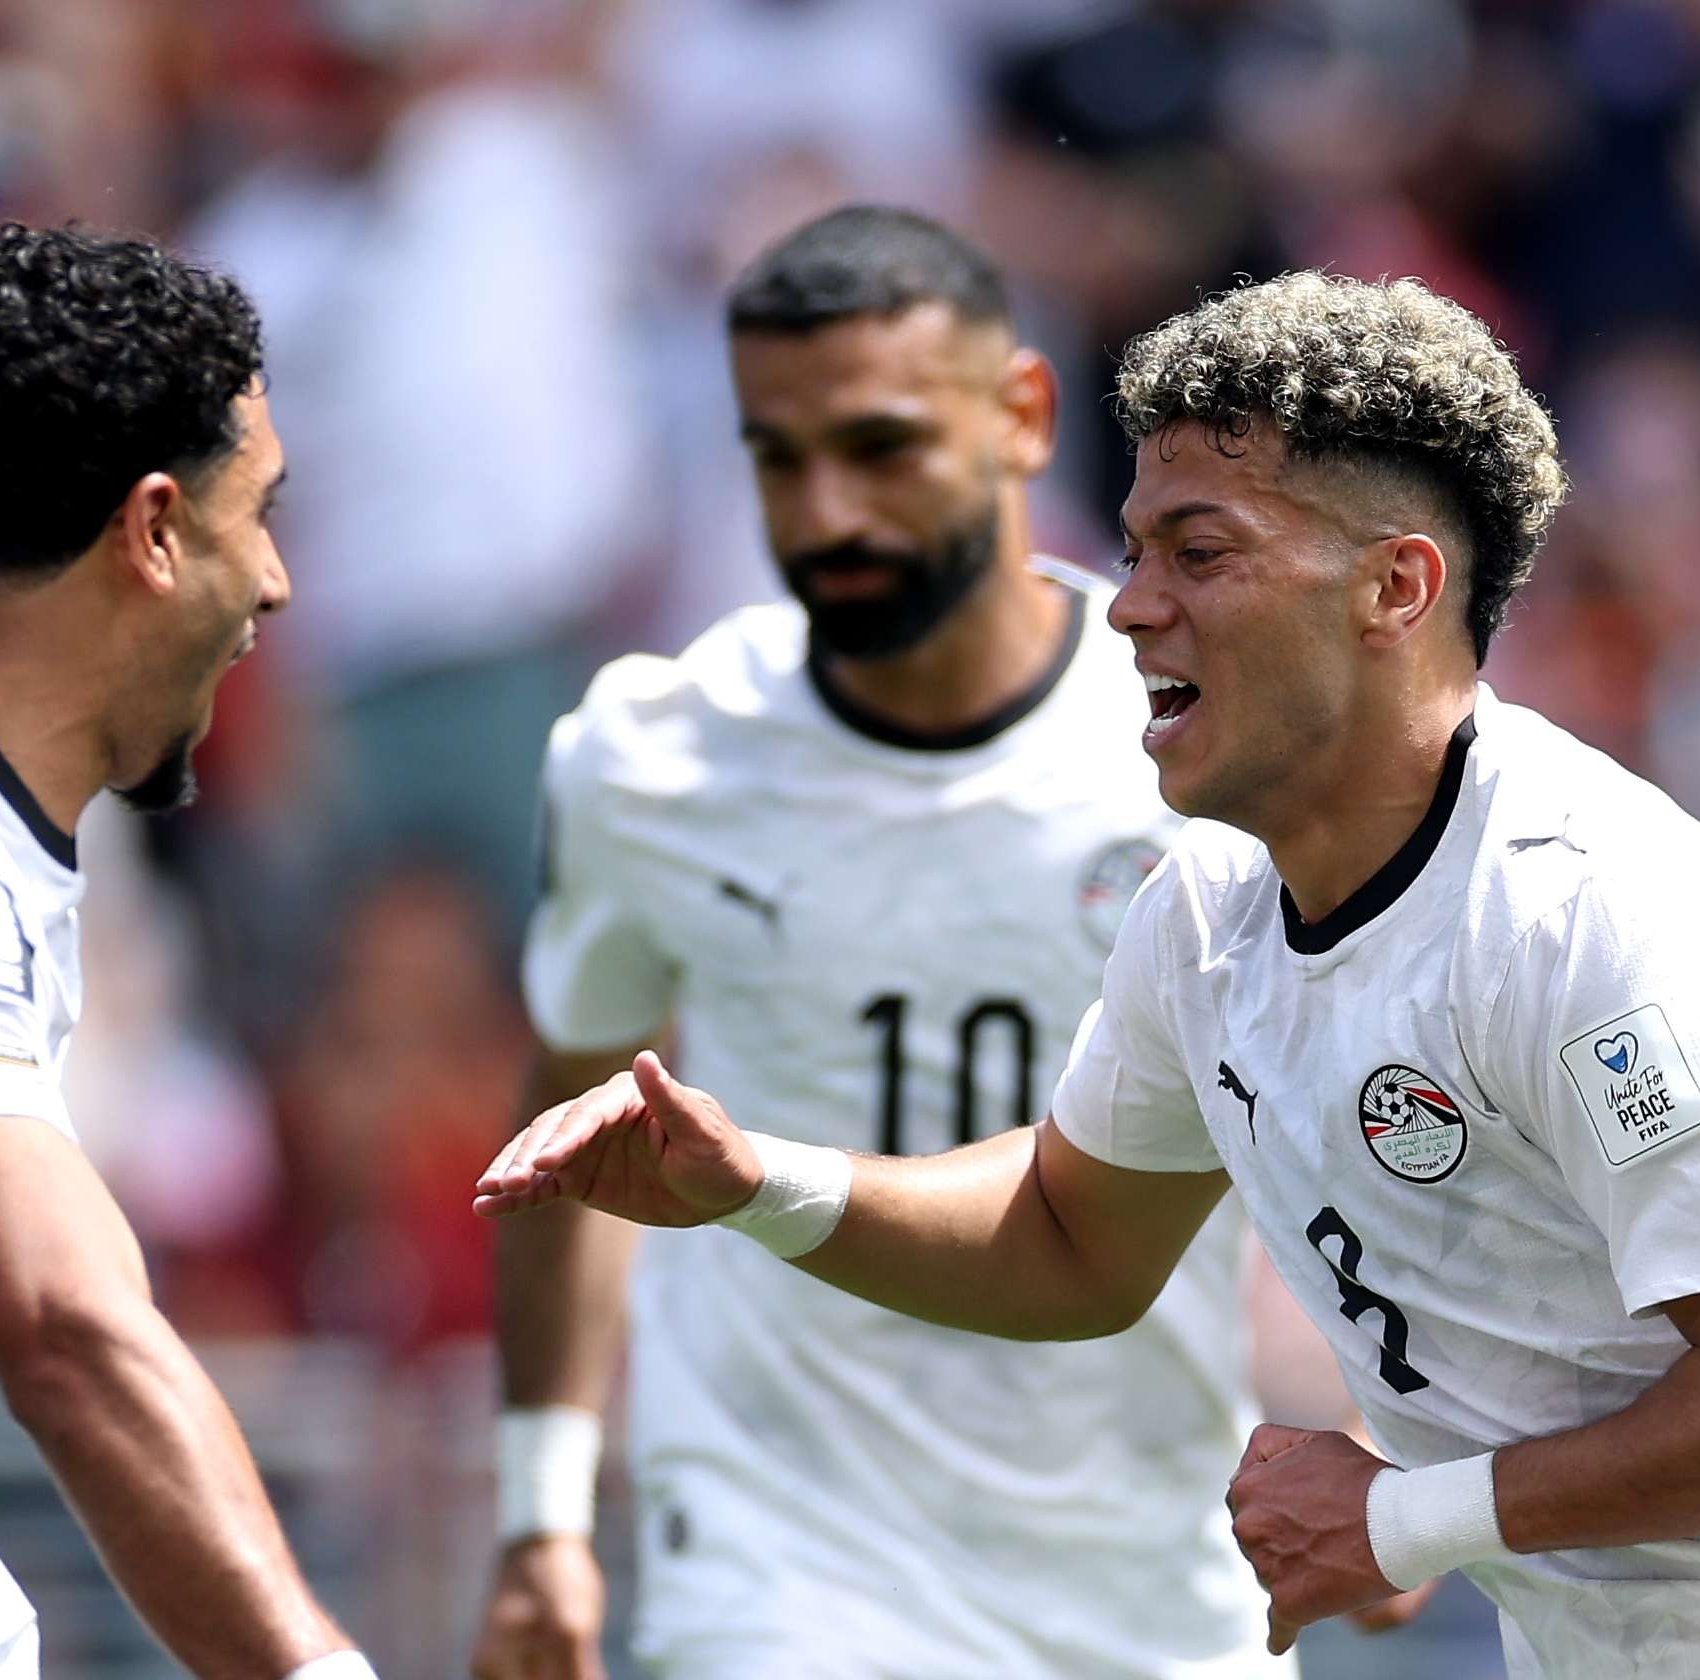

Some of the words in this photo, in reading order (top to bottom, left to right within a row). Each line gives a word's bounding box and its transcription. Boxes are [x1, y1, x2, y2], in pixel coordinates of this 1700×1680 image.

[1604, 1078, 1642, 1110] Unite
[1639, 1065, 1664, 1092] For
[1617, 1089, 1675, 1132] PEACE
[1638, 1120, 1670, 1141] FIFA
[1401, 1160, 1440, 1172] EGYPTIAN
[1439, 1153, 1450, 1164] FA
